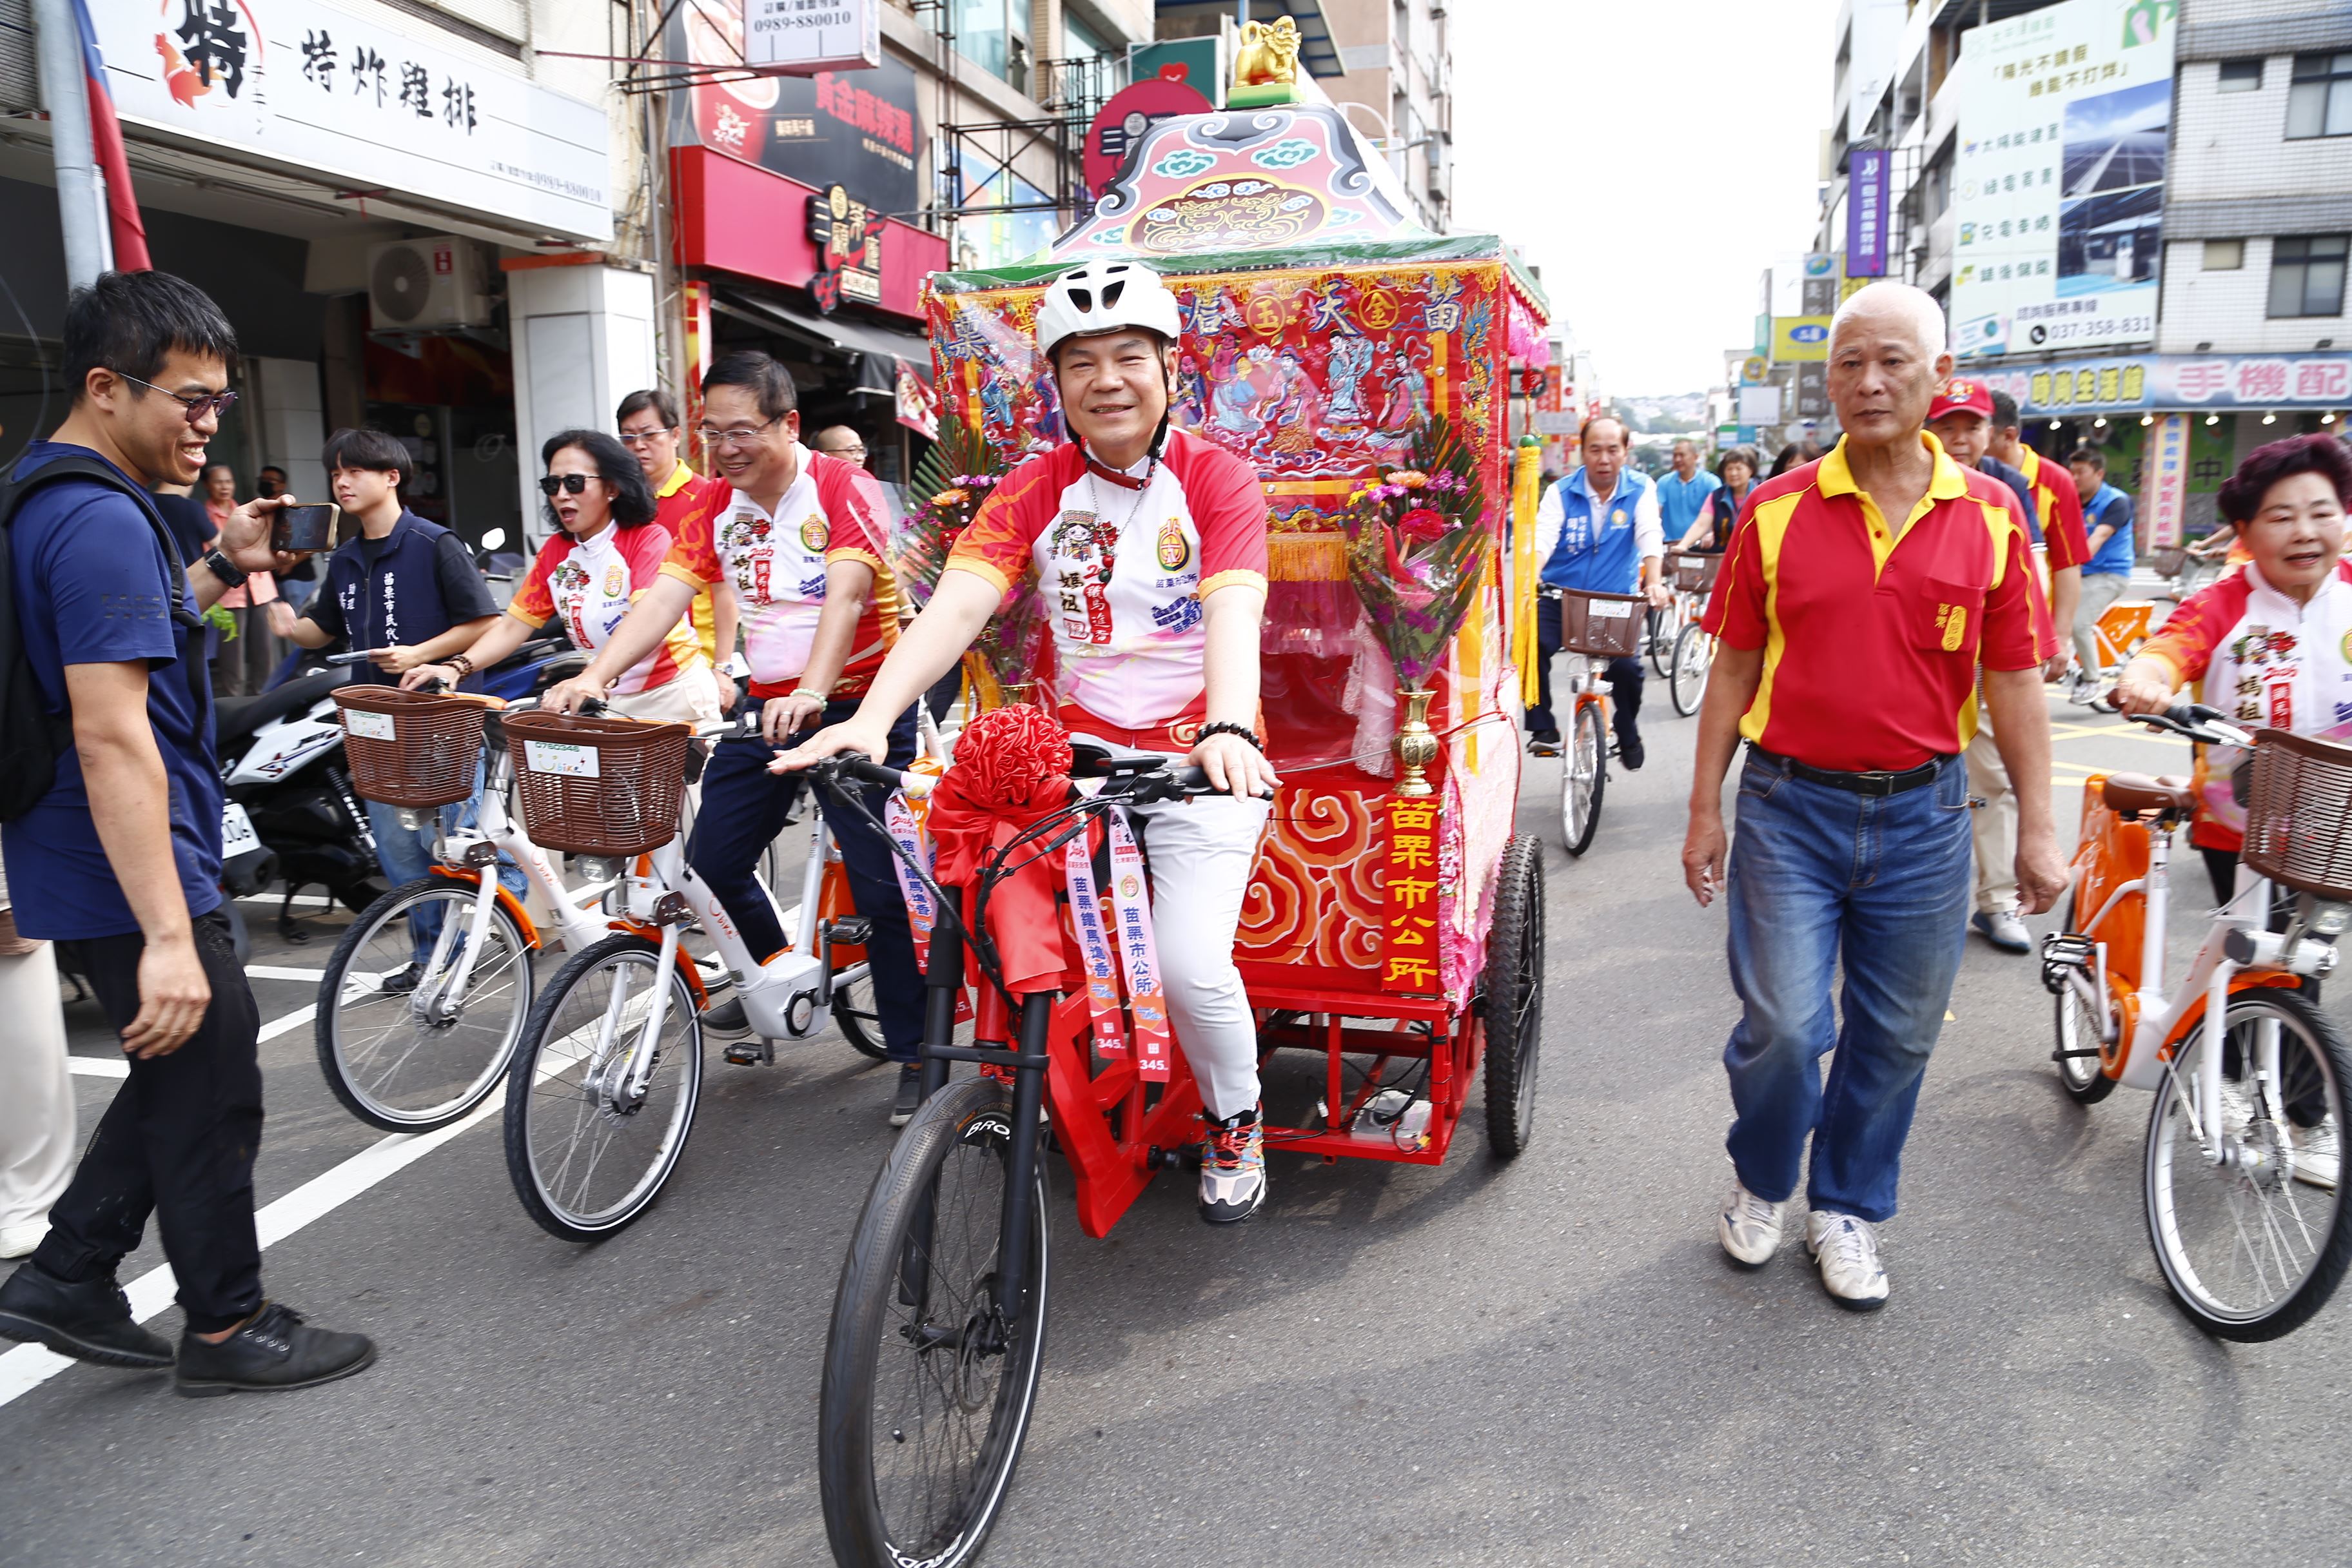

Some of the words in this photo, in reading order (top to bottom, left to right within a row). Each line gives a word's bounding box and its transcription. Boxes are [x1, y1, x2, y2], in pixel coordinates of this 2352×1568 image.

[754, 11, 851, 32] 0989-880010
[300, 28, 477, 136] 特炸雞排
[2050, 316, 2151, 340] 037-358-831
[2177, 363, 2347, 398] 手機配
[1057, 569, 1084, 613] 媽祖
[1383, 799, 1438, 988] 苗栗市公所
[1122, 906, 1152, 993] 苗栗市公所
[1139, 1059, 1164, 1070] 345
